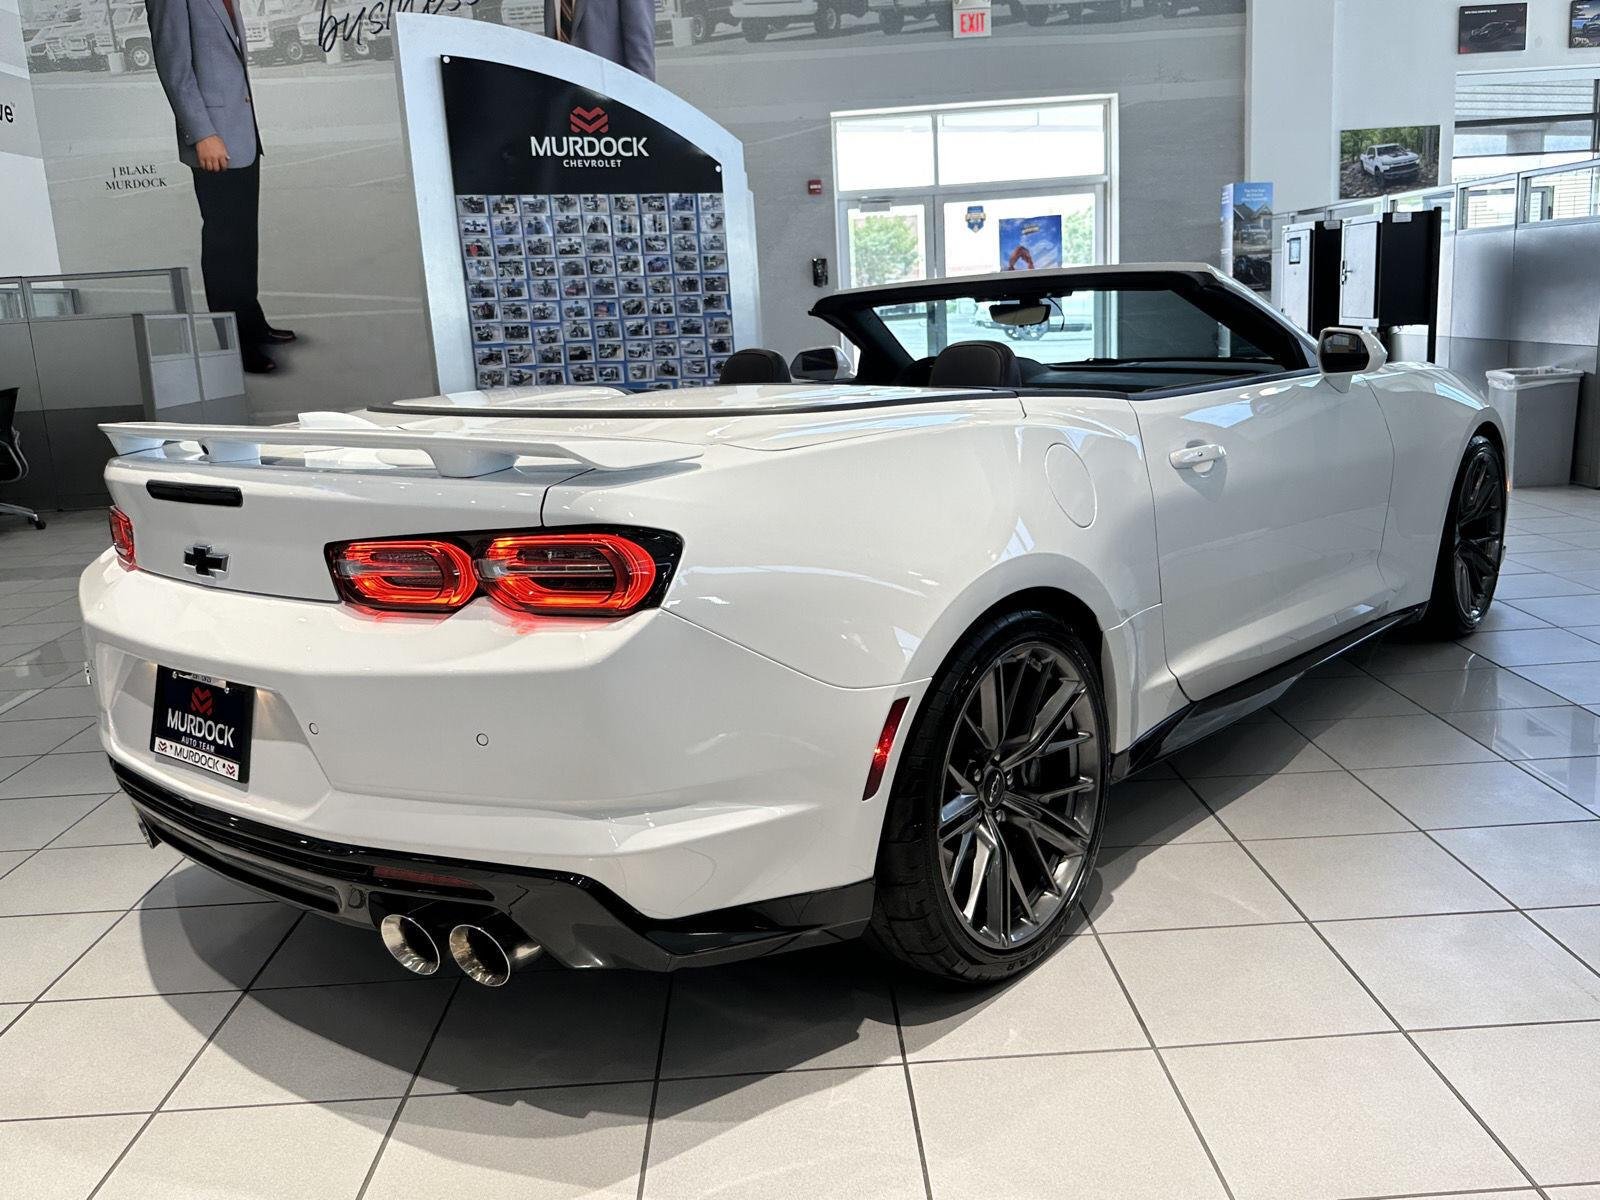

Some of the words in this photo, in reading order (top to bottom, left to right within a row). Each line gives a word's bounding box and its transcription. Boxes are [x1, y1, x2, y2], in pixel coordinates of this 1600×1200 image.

[959, 12, 986, 33] EXIT
[529, 136, 650, 157] MURDOCK
[119, 164, 157, 176] BLAKE
[563, 159, 622, 168] CHEVROLET
[105, 177, 168, 190] MURDOCK
[166, 707, 236, 749] MURDOCK
[181, 735, 197, 748] AUTO
[199, 741, 216, 754] TEAM
[174, 745, 220, 772] MURDOCK
